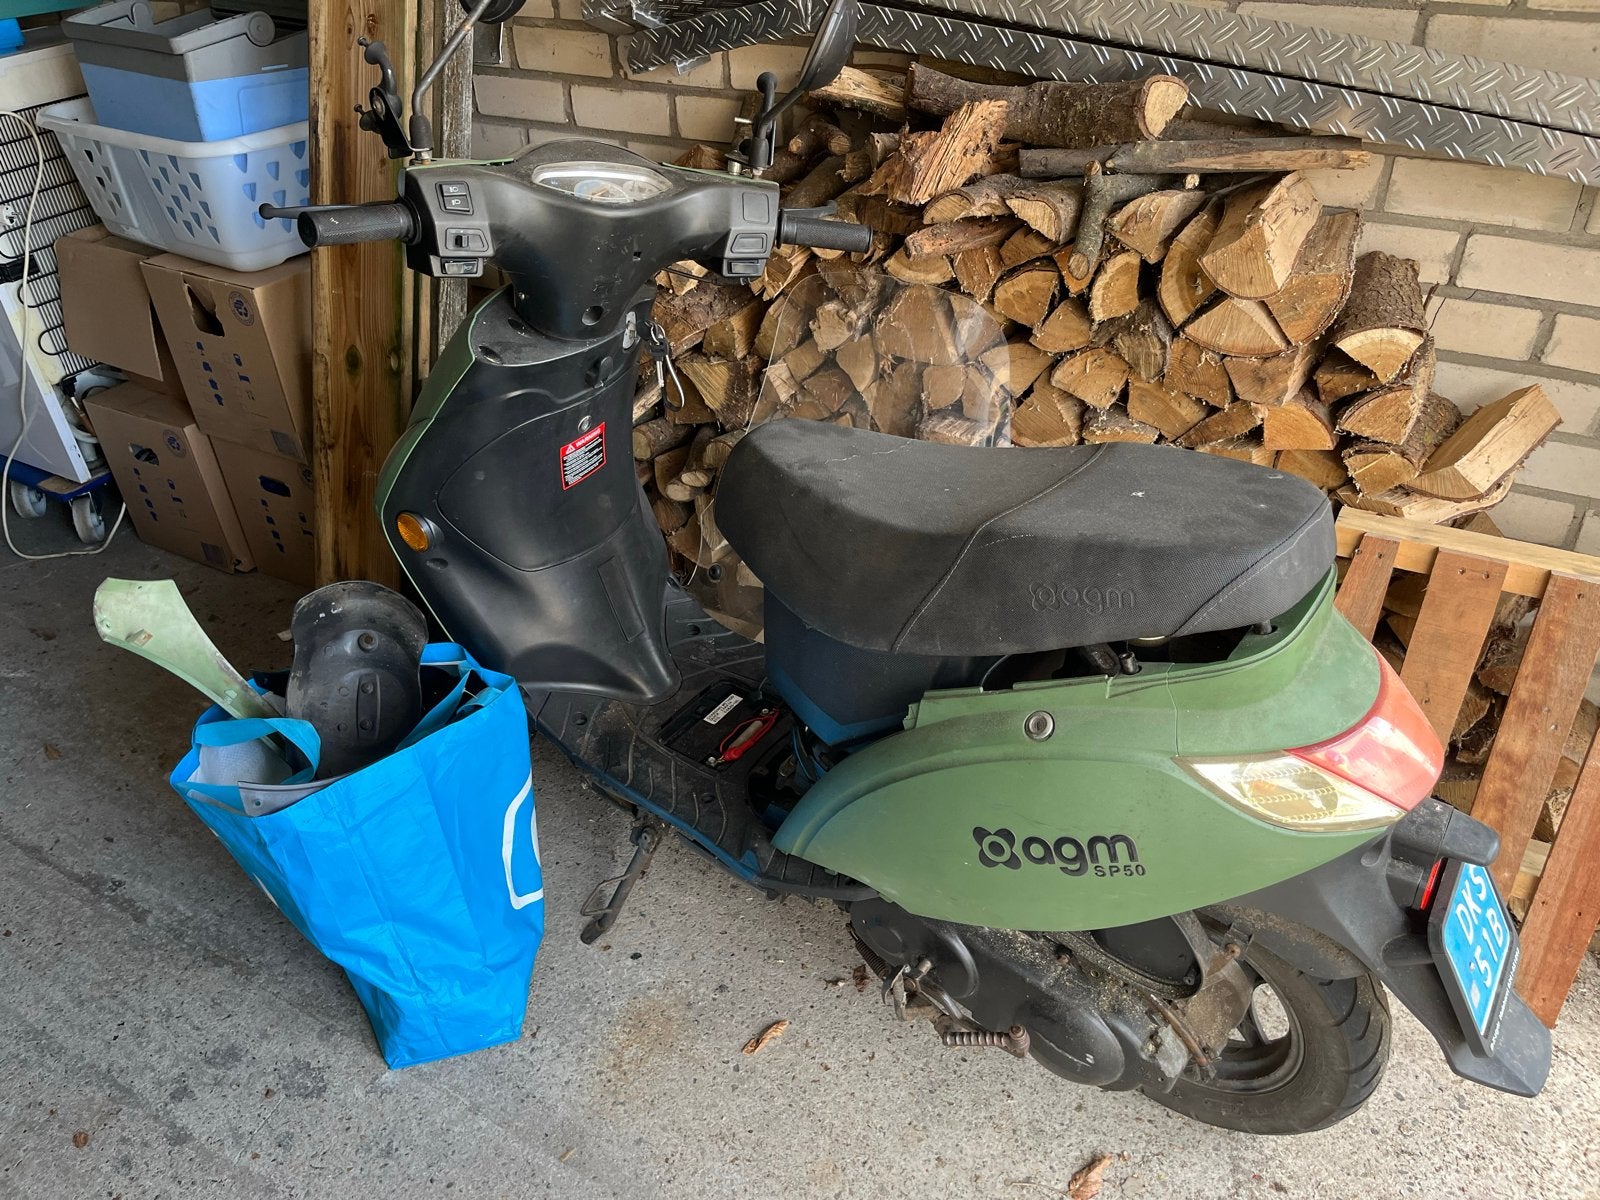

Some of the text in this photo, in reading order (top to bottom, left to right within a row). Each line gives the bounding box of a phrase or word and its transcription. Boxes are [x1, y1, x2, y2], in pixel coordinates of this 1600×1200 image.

[1060, 585, 1136, 616] agm
[1022, 834, 1139, 876] agm
[1094, 864, 1146, 877] SP50
[1455, 864, 1487, 945] DKS
[1474, 907, 1504, 989] 51B
